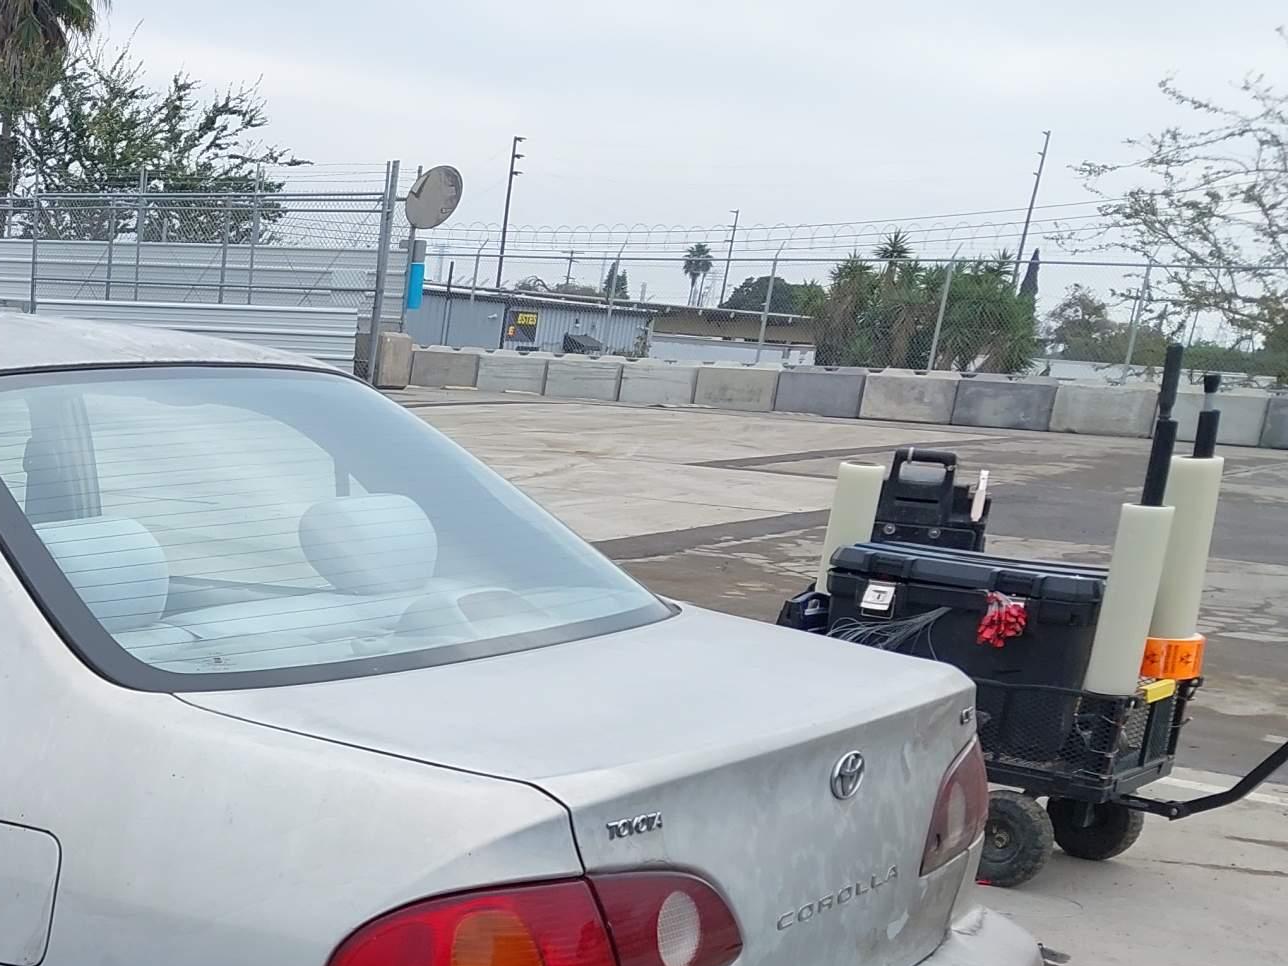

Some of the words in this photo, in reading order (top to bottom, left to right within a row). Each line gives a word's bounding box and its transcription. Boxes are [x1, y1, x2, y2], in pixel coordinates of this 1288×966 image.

[517, 313, 537, 325] ESTES
[606, 811, 663, 841] TOYOTA
[777, 864, 898, 931] COROLLA
